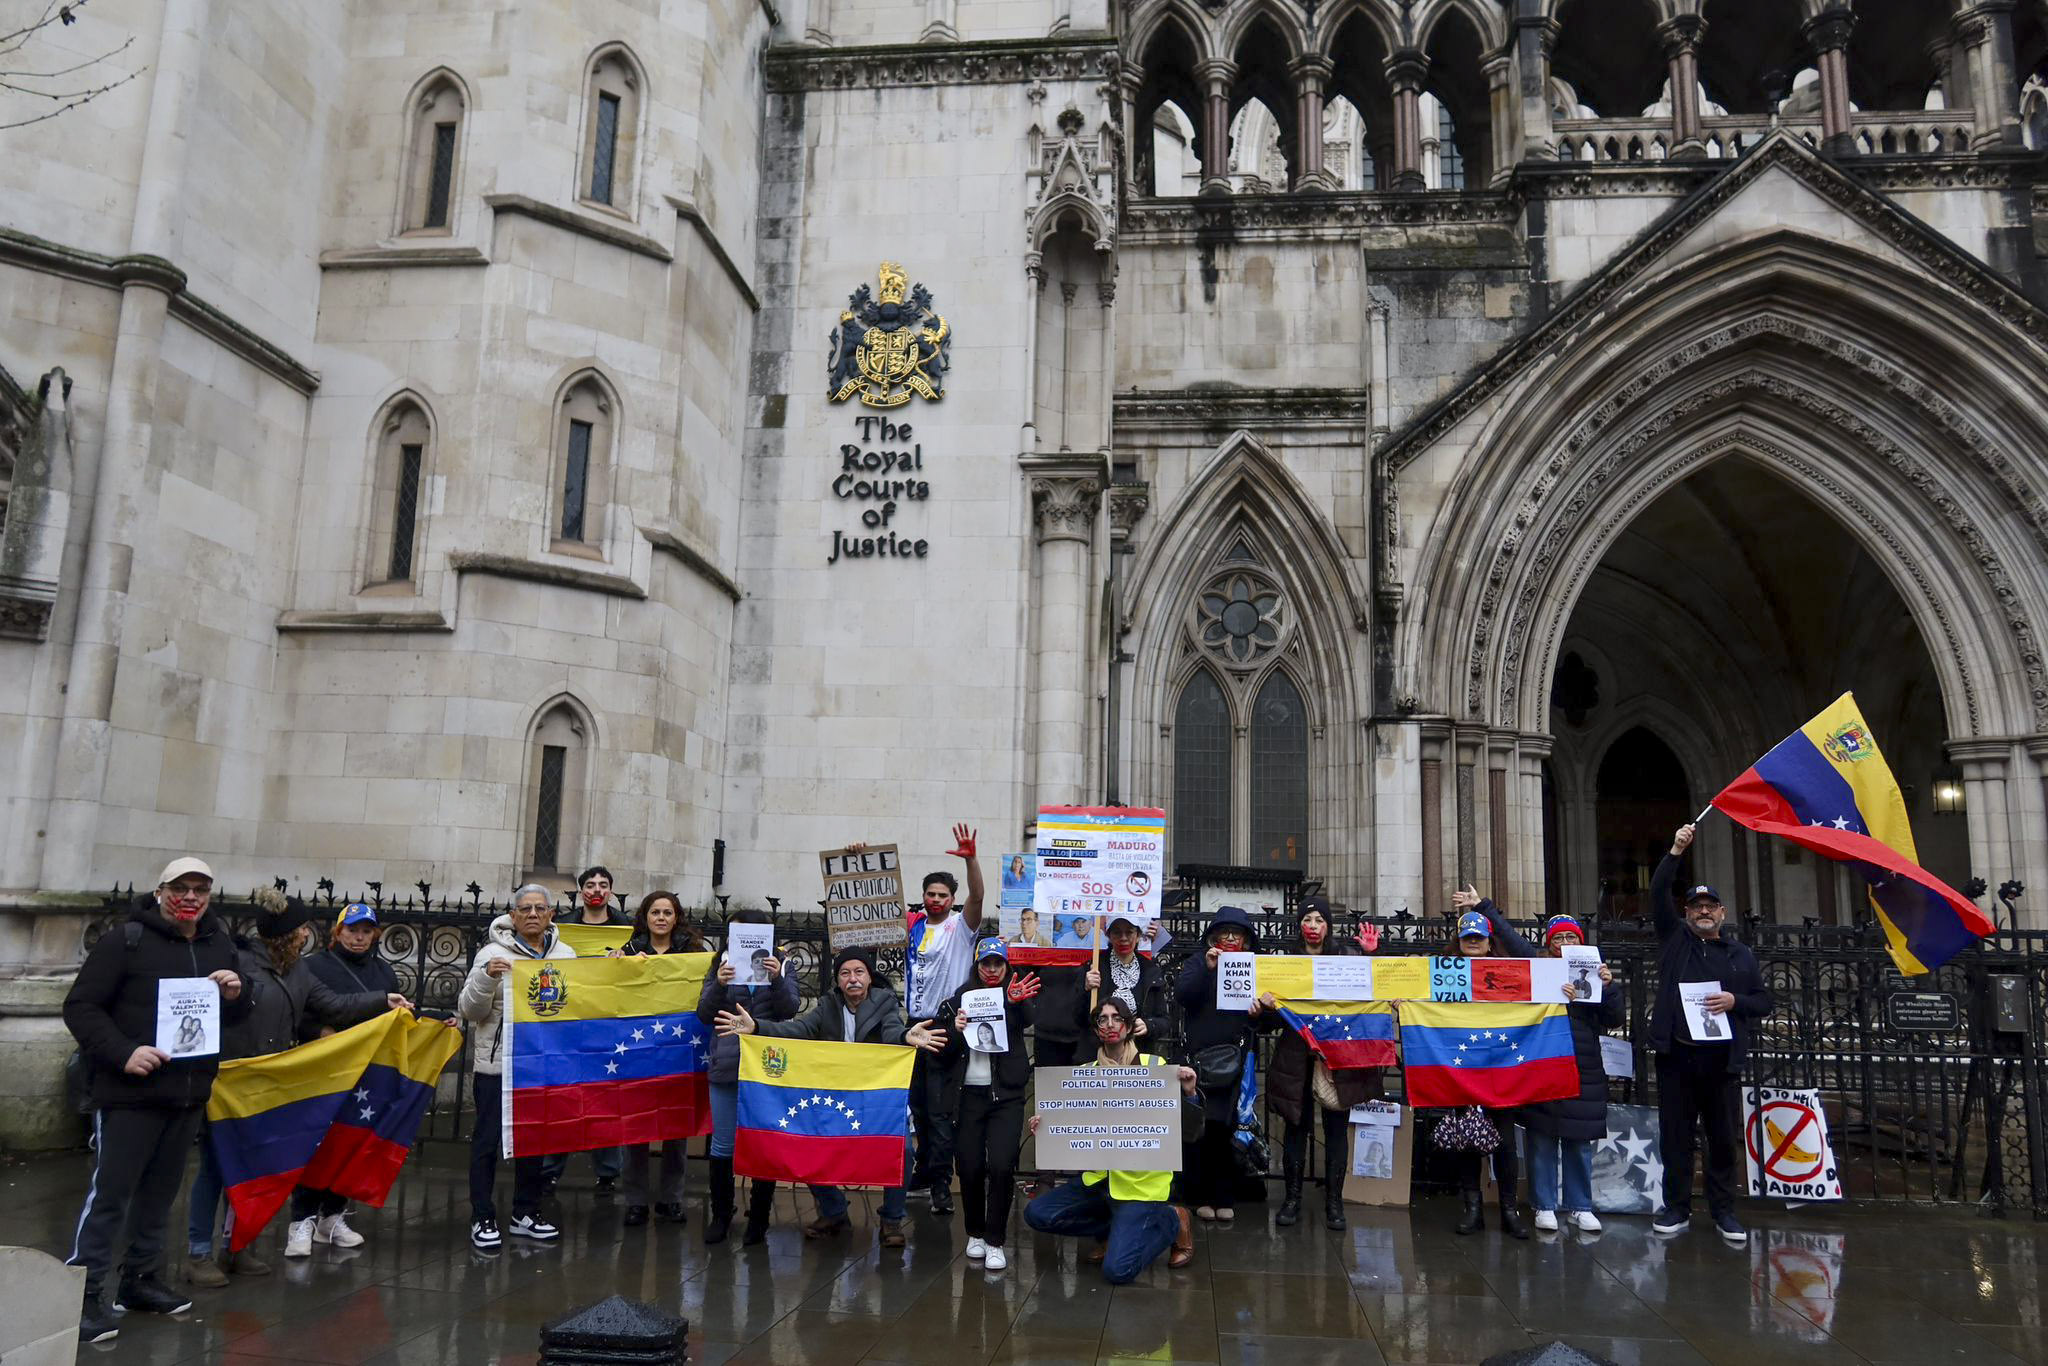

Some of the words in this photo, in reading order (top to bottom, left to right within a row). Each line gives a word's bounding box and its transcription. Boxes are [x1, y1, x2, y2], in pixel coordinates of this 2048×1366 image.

[855, 416, 912, 441] The
[840, 444, 922, 475] Royal
[832, 474, 929, 498] Courts
[862, 501, 896, 527] of
[827, 530, 928, 565] Justice
[1052, 840, 1087, 848] LIBERTAD
[1107, 841, 1156, 851] MADURO
[1038, 849, 1055, 857] PARA
[825, 851, 897, 875] FREE
[828, 881, 851, 901] ALL
[853, 877, 897, 898] POLITICAL
[1081, 882, 1113, 895] SOS
[829, 901, 902, 923] PRISONERS
[1049, 899, 1145, 913] VENEZUELA
[1435, 957, 1465, 970] ICC
[1223, 979, 1251, 991] SOS
[1434, 974, 1467, 987] SOS
[1435, 992, 1467, 1002] VZLA
[1101, 1068, 1148, 1076] TORTURED
[1112, 1080, 1165, 1088] PRISONERS.
[1773, 1089, 1789, 1099] TO
[1793, 1092, 1815, 1109] HELL
[1049, 1126, 1107, 1134] VENEZUELAN
[1112, 1126, 1168, 1134] DEMOCRACY
[1100, 1140, 1113, 1148] ON
[1118, 1140, 1140, 1148] JULY
